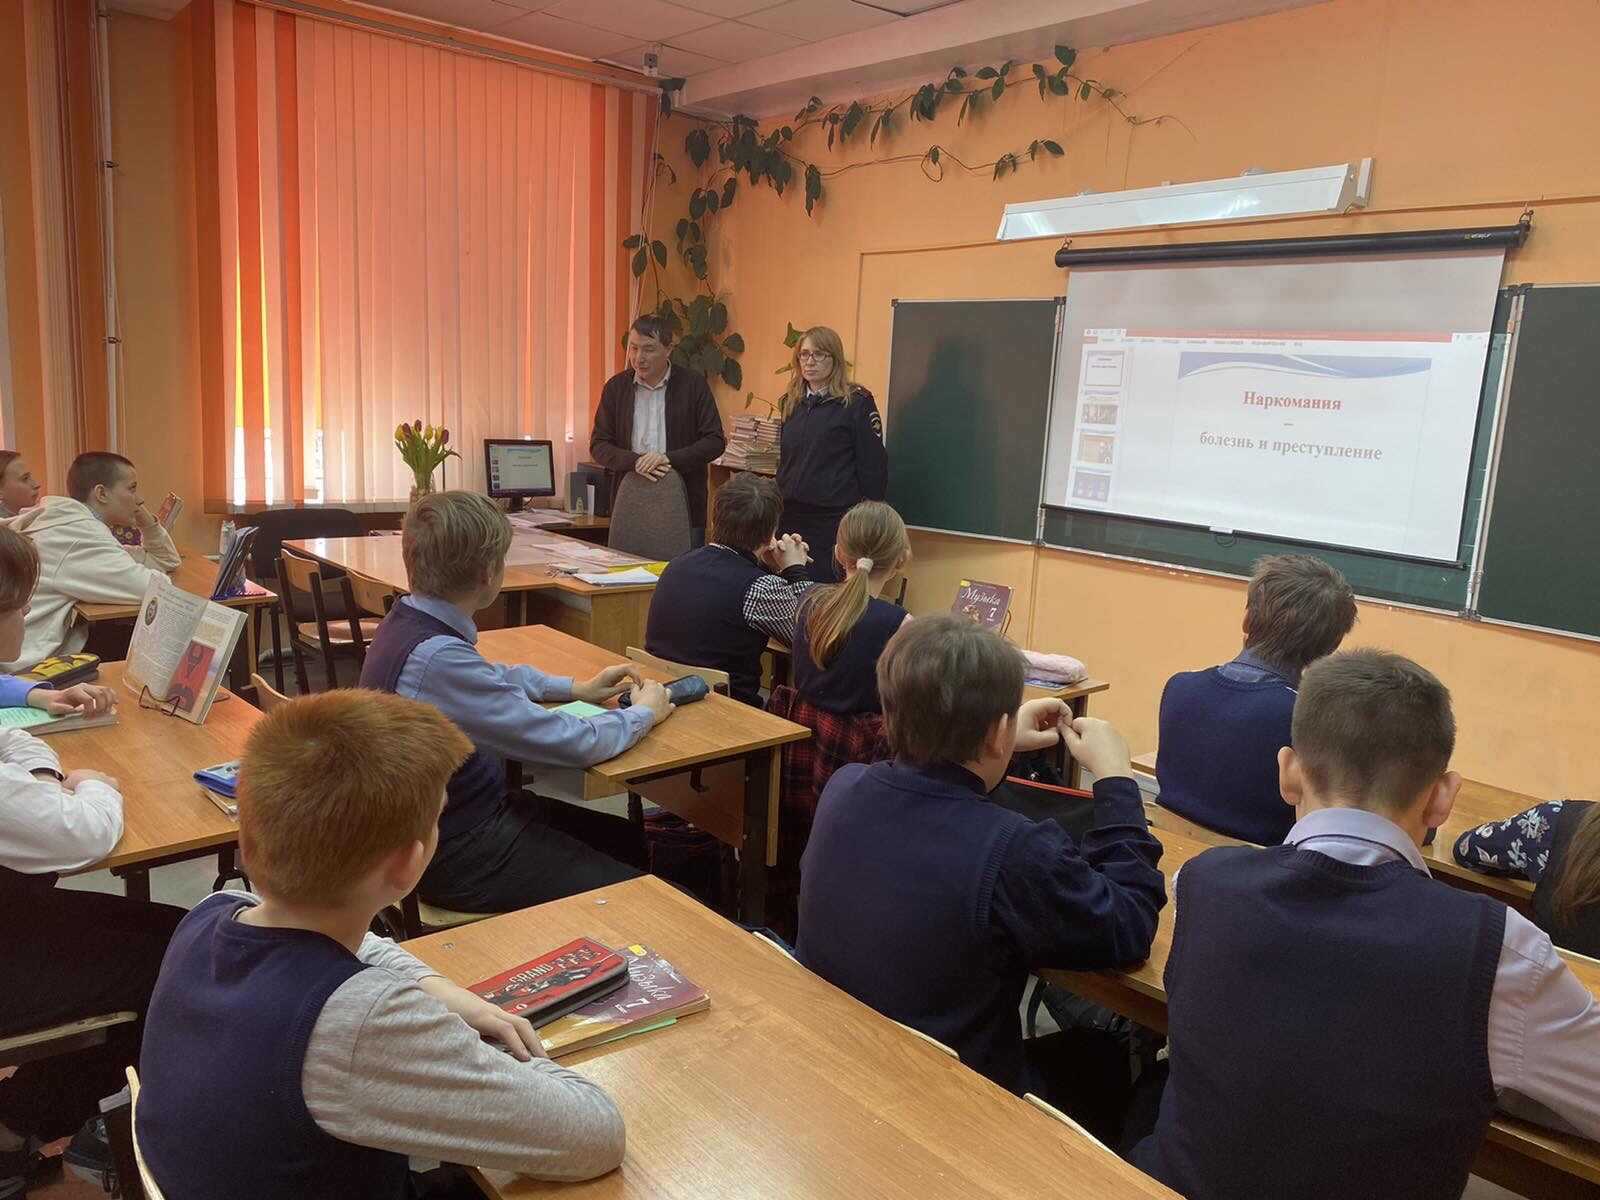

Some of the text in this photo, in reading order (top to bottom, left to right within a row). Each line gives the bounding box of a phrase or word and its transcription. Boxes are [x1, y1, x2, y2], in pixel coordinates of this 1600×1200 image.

[1243, 391, 1342, 411] Наркомания
[1200, 432, 1383, 460] болезнь и преступление
[961, 587, 1000, 606] Музыка
[989, 607, 998, 618] 7
[509, 962, 554, 984] GRAND
[628, 955, 675, 1001] Музыка
[626, 997, 651, 1009] 7
